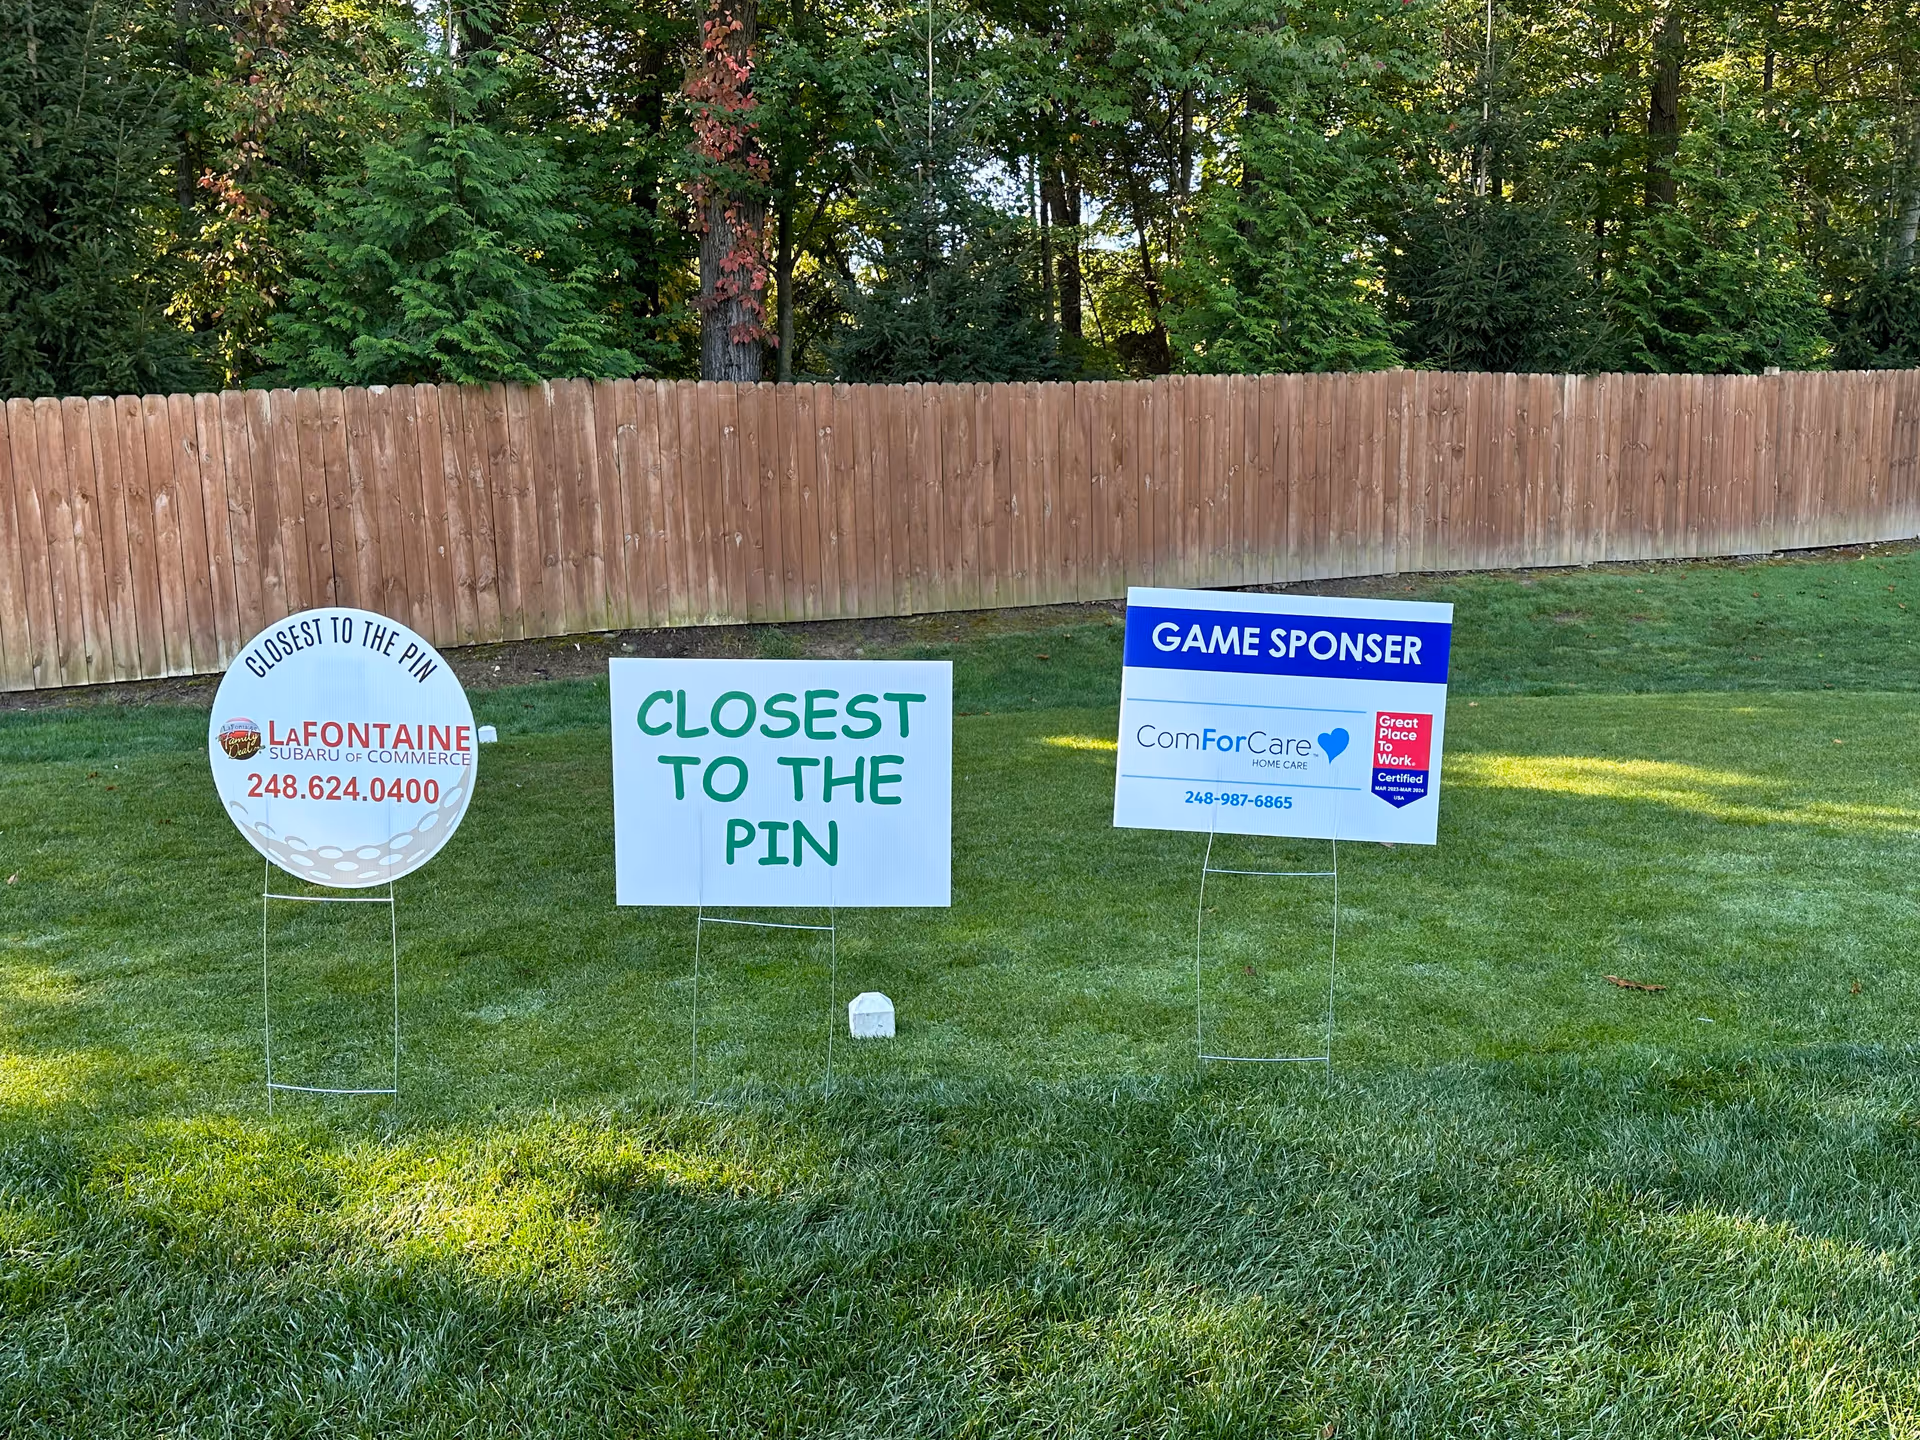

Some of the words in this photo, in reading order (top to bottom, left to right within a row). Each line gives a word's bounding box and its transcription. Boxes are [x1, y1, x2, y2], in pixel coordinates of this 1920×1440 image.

[244, 617, 323, 679] CLOSEST
[330, 616, 353, 644] TO
[361, 619, 400, 658] THE
[398, 641, 439, 684] PIN
[1151, 621, 1261, 657] GAME
[1268, 627, 1423, 665] SPONSER
[636, 688, 927, 740] CLOSEST
[1379, 715, 1419, 729] Great
[222, 730, 260, 749] Family
[1136, 724, 1312, 757] ComForCare
[1379, 728, 1418, 741] Place
[1377, 740, 1393, 752] To
[269, 747, 340, 762] SUBARU
[367, 749, 471, 766] COMMERCE
[1252, 758, 1281, 769] HOME
[1283, 759, 1308, 770] CARE
[247, 772, 440, 804] 248.624.0400
[657, 754, 749, 803] TO
[776, 754, 906, 805] THE
[1377, 772, 1424, 784] Certified
[1184, 790, 1293, 810] 248-987-6865
[725, 818, 839, 867] PIN
